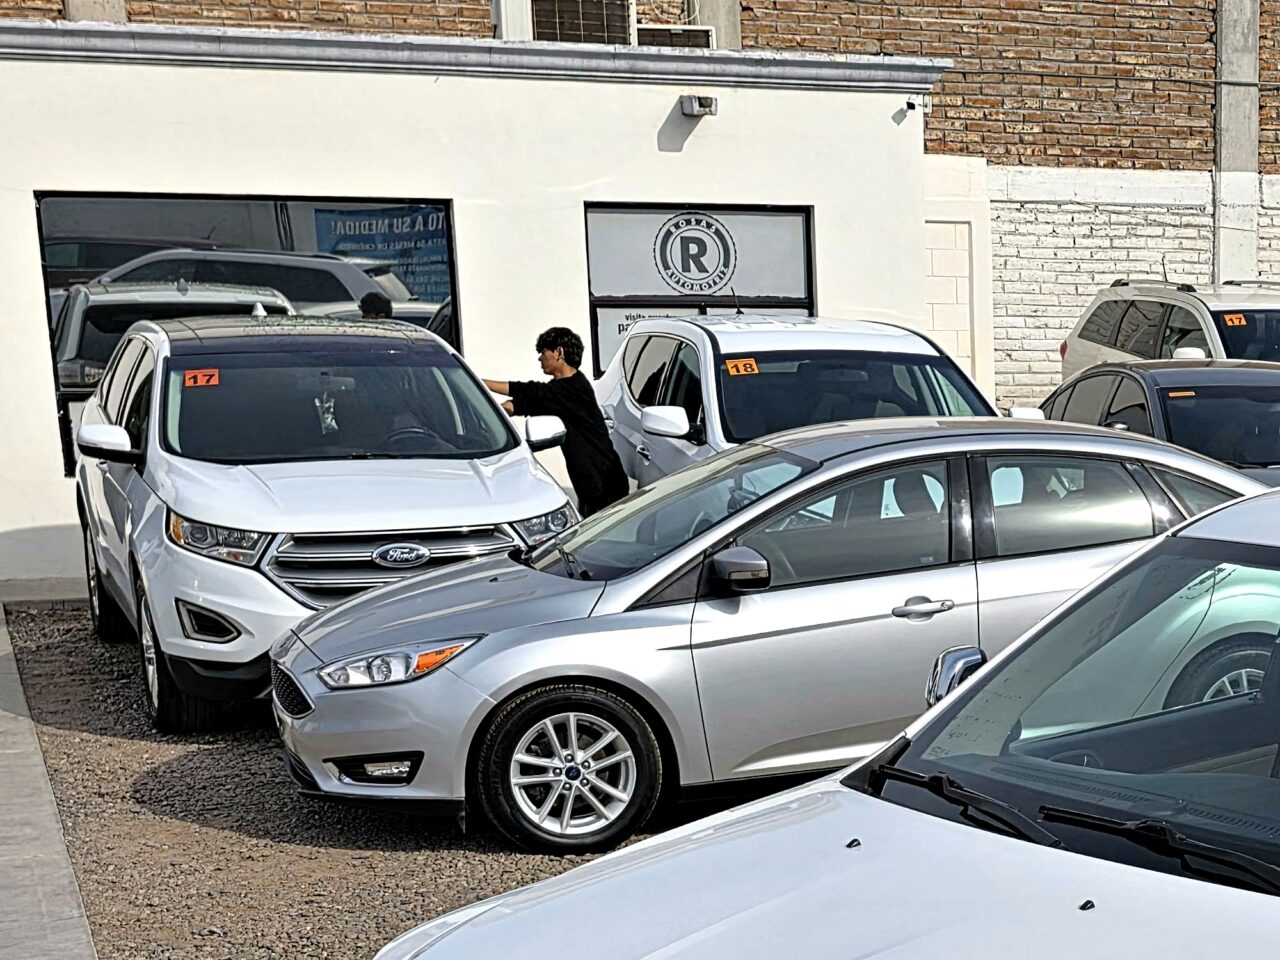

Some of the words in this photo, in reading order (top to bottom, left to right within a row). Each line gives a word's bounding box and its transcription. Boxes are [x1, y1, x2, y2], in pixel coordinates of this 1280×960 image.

[669, 218, 717, 233] ROSAS
[680, 236, 710, 273] R
[665, 266, 729, 292] AUTOMOTRIZ
[1228, 317, 1243, 325] 17
[731, 362, 756, 373] 18
[188, 373, 216, 385] 17
[387, 548, 418, 561] Ford
